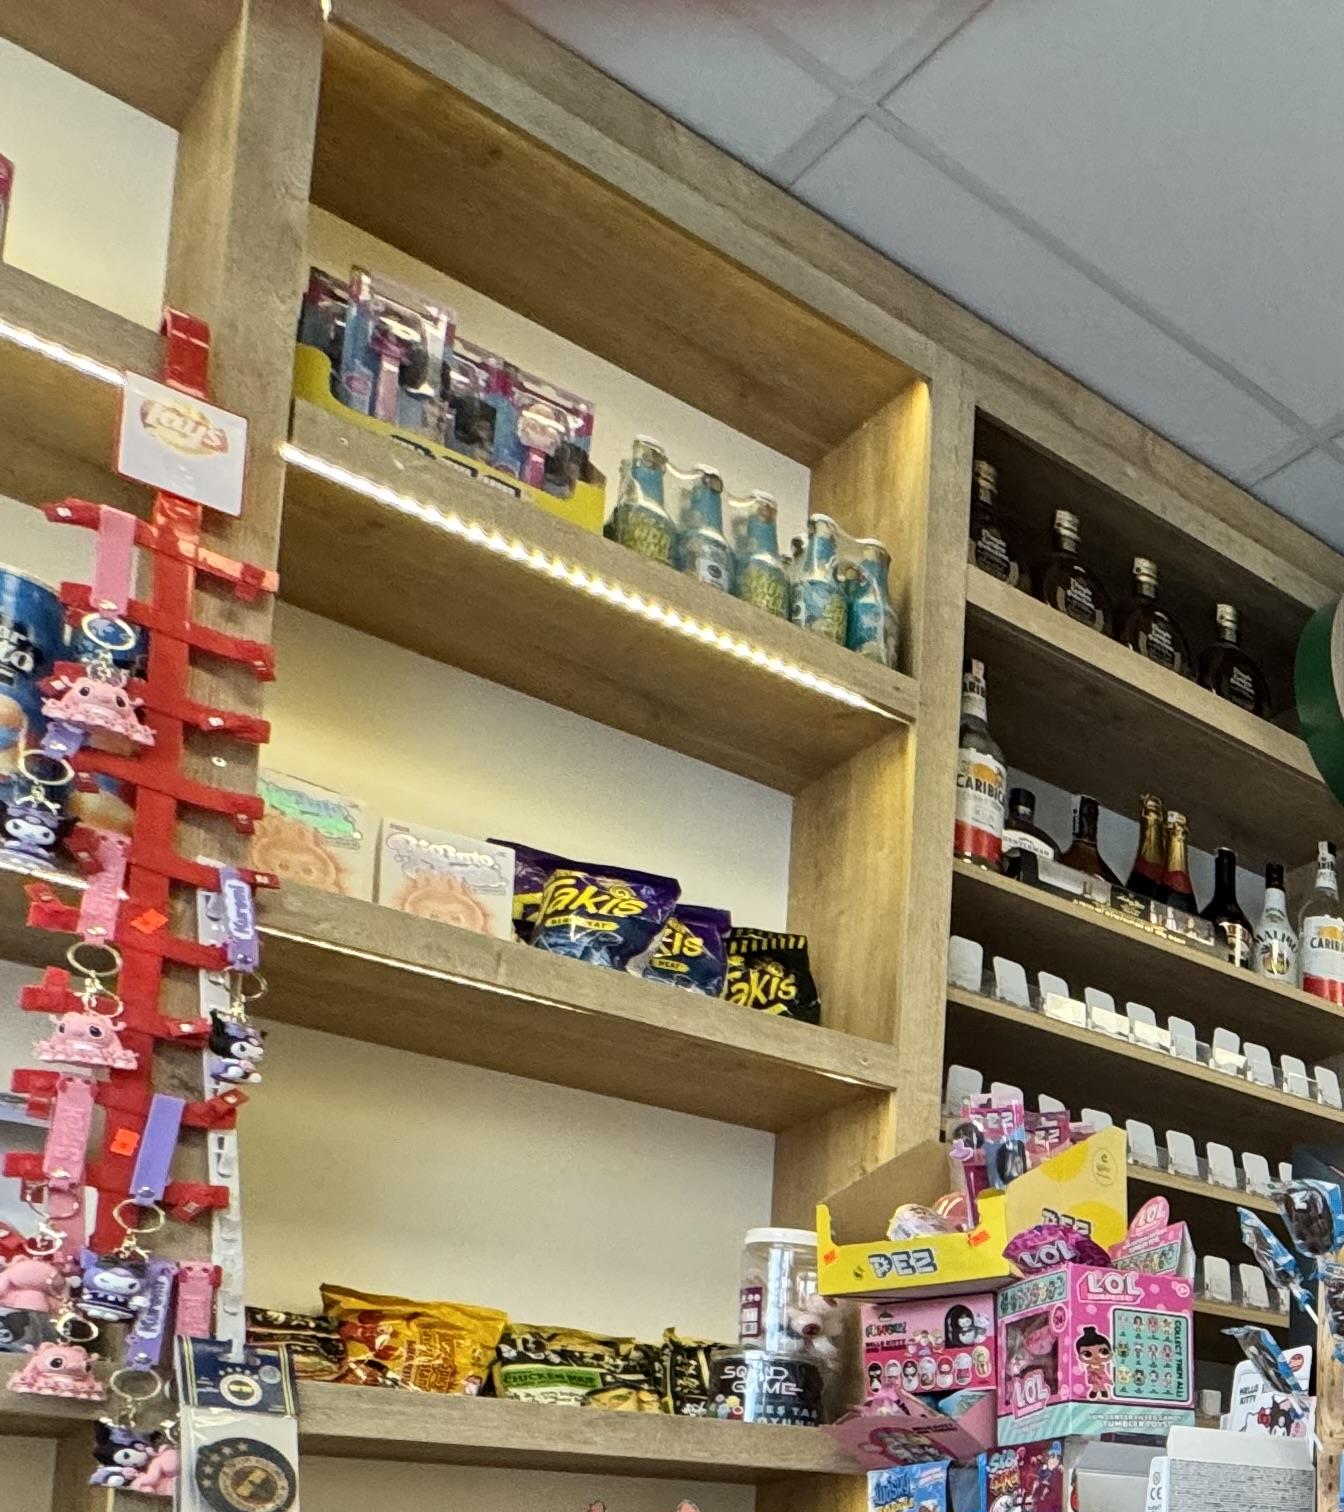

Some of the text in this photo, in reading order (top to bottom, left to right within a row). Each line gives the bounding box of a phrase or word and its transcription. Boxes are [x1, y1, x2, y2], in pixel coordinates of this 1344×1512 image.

[545, 879, 649, 917] Takis
[653, 925, 704, 958] kis
[867, 1248, 938, 1279] PEZ
[1087, 1272, 1141, 1295] LOL
[1174, 1320, 1182, 1357] COLLECT
[1176, 1359, 1184, 1381] THEM
[731, 1382, 803, 1395] GAME
[1015, 1372, 1048, 1406] LOL
[1239, 1385, 1259, 1396] HELLO
[1239, 1396, 1257, 1405] KITTY
